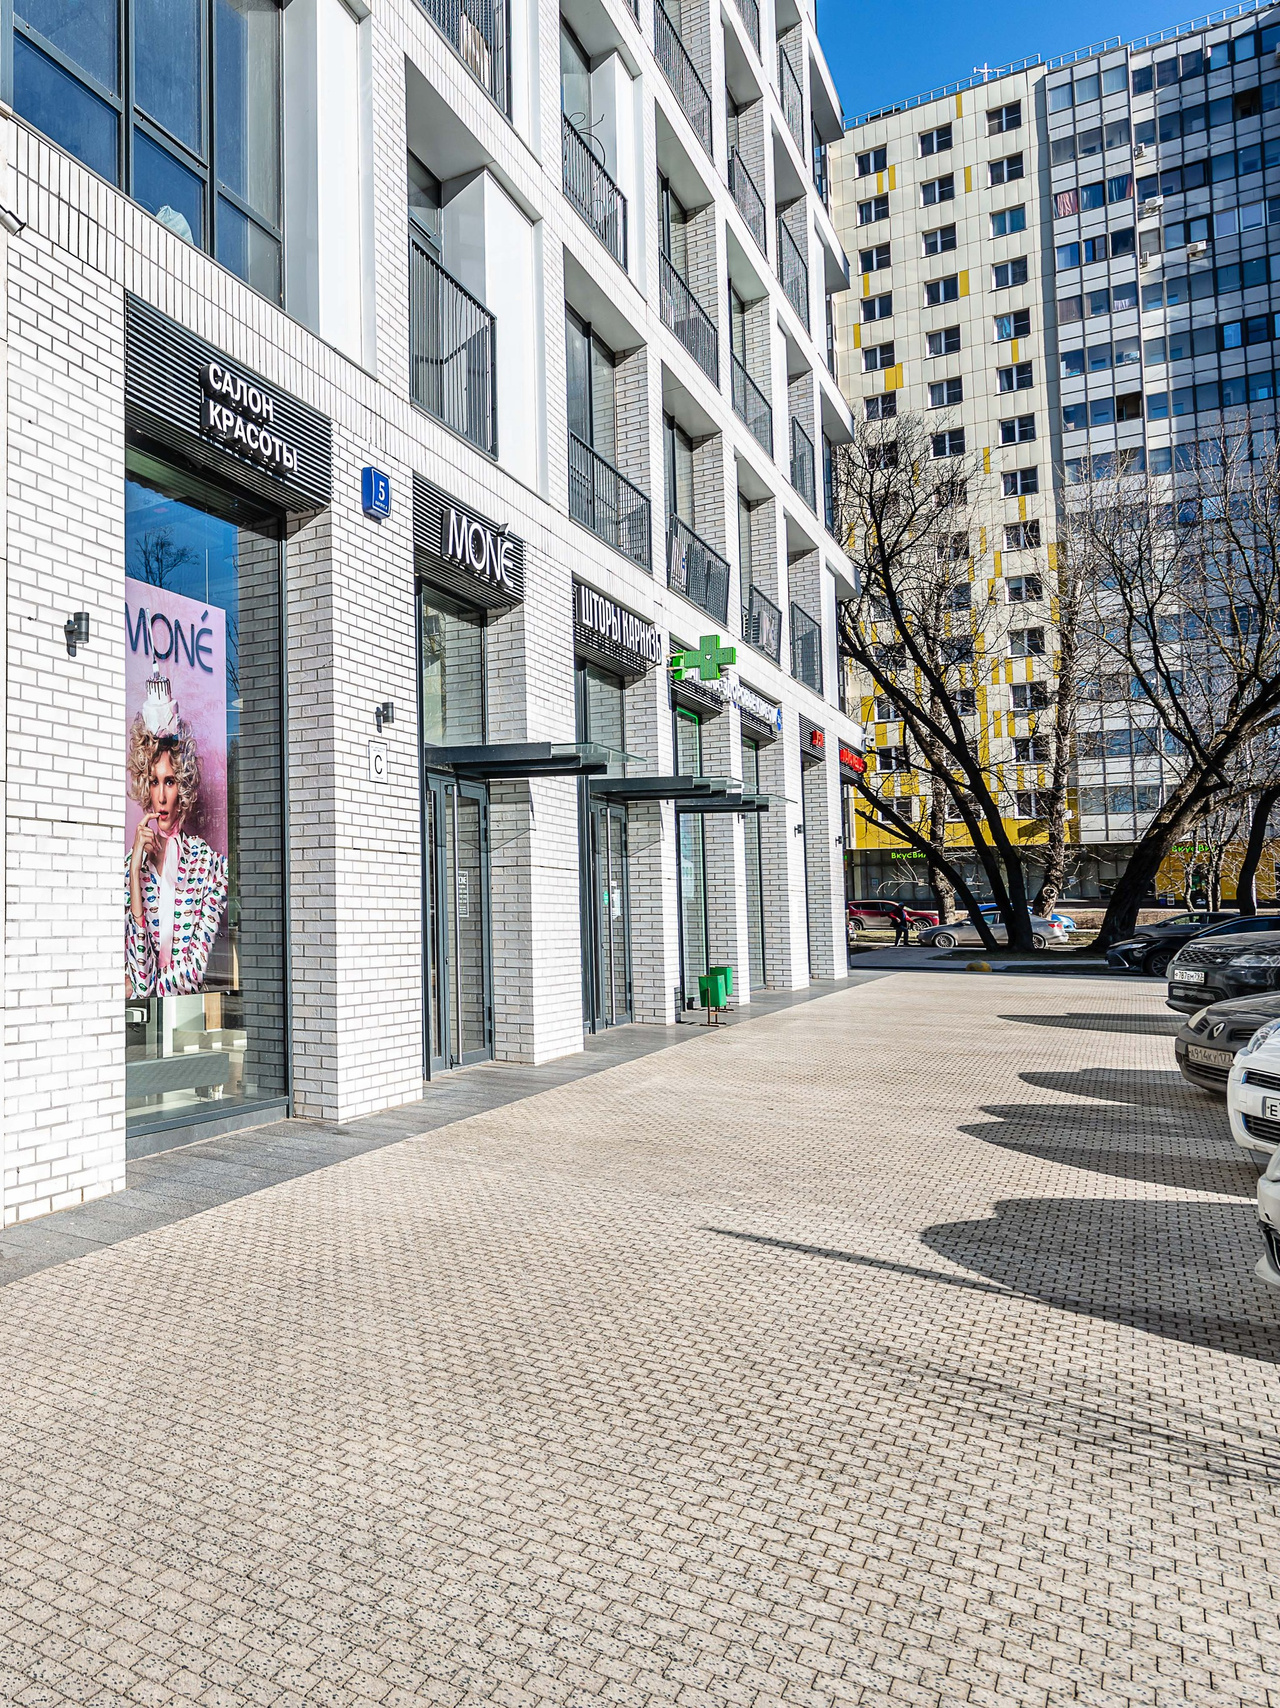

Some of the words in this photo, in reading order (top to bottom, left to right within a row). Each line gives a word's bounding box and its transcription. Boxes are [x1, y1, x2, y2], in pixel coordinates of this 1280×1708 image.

[209, 362, 274, 422] САЛОН
[209, 399, 298, 472] КРАСОТЫ
[378, 480, 386, 501] 5
[448, 508, 514, 588] MONÉ
[125, 602, 214, 673] MONÉ
[581, 585, 622, 643] ШТОРЫ
[890, 851, 927, 860] ВкусВи
